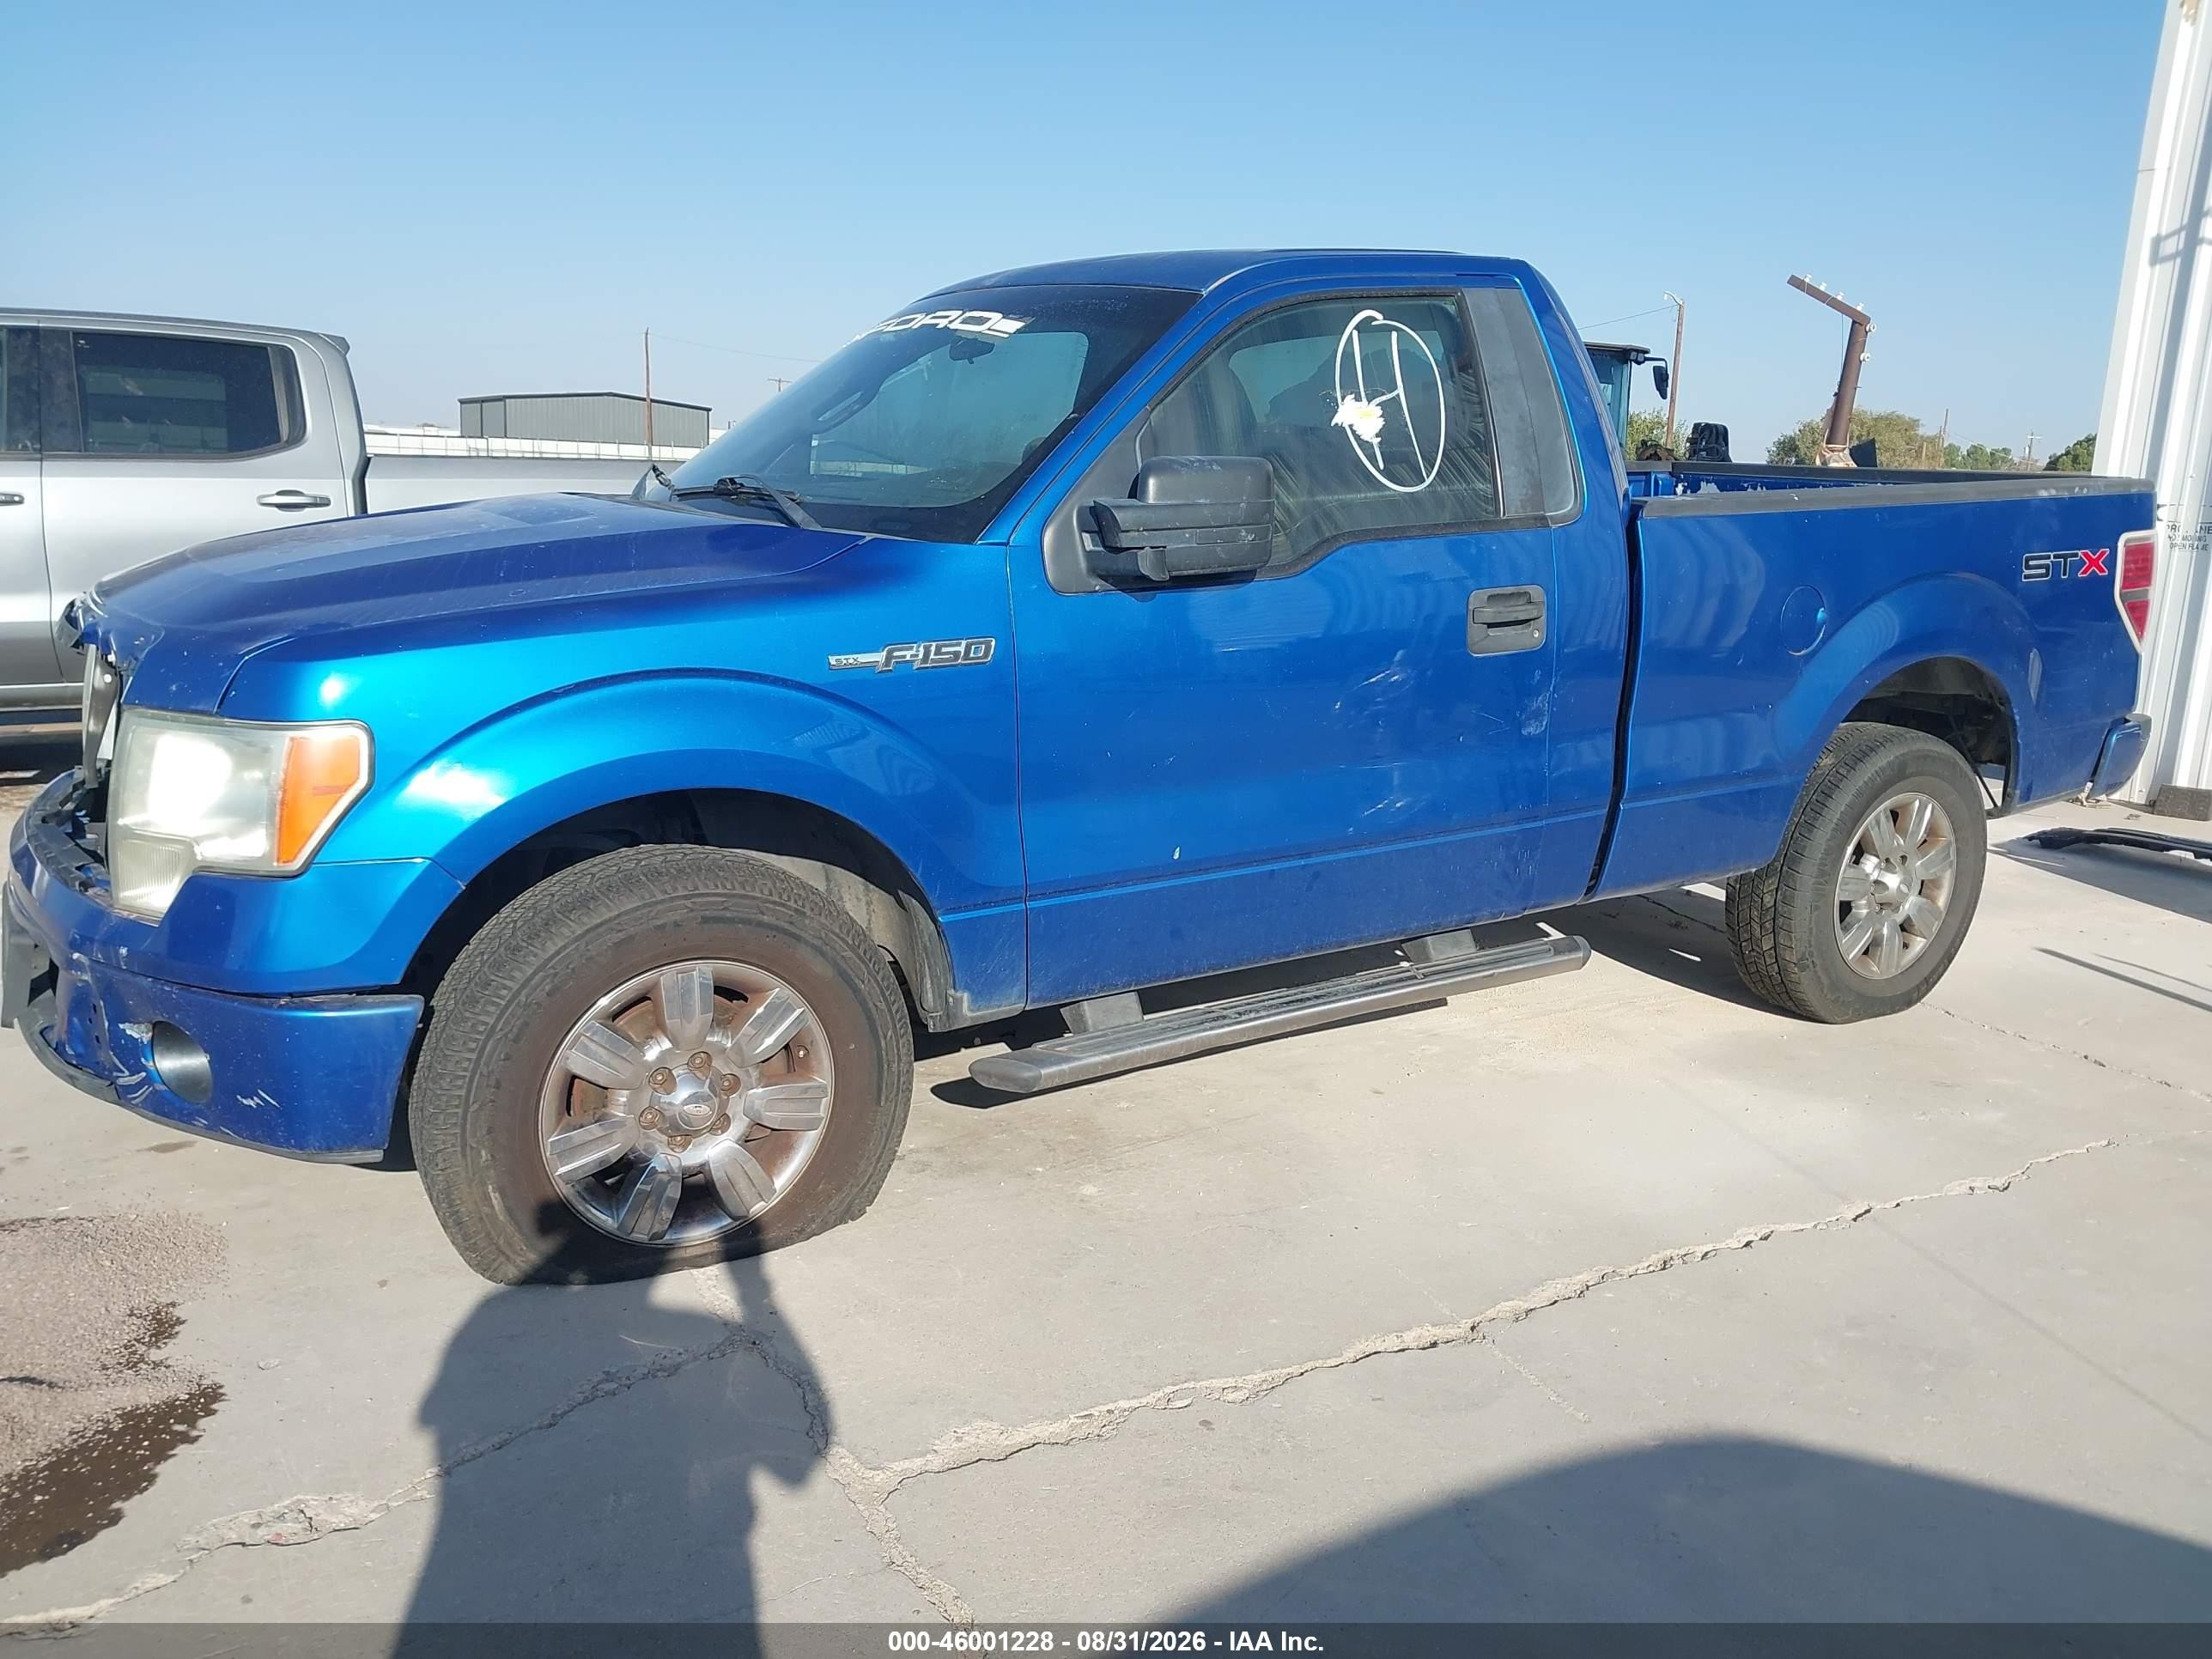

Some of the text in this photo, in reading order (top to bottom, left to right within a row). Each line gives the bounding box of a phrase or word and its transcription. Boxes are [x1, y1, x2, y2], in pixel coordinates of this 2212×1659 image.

[2021, 549, 2110, 581] STX
[835, 636, 996, 673] STX F-150
